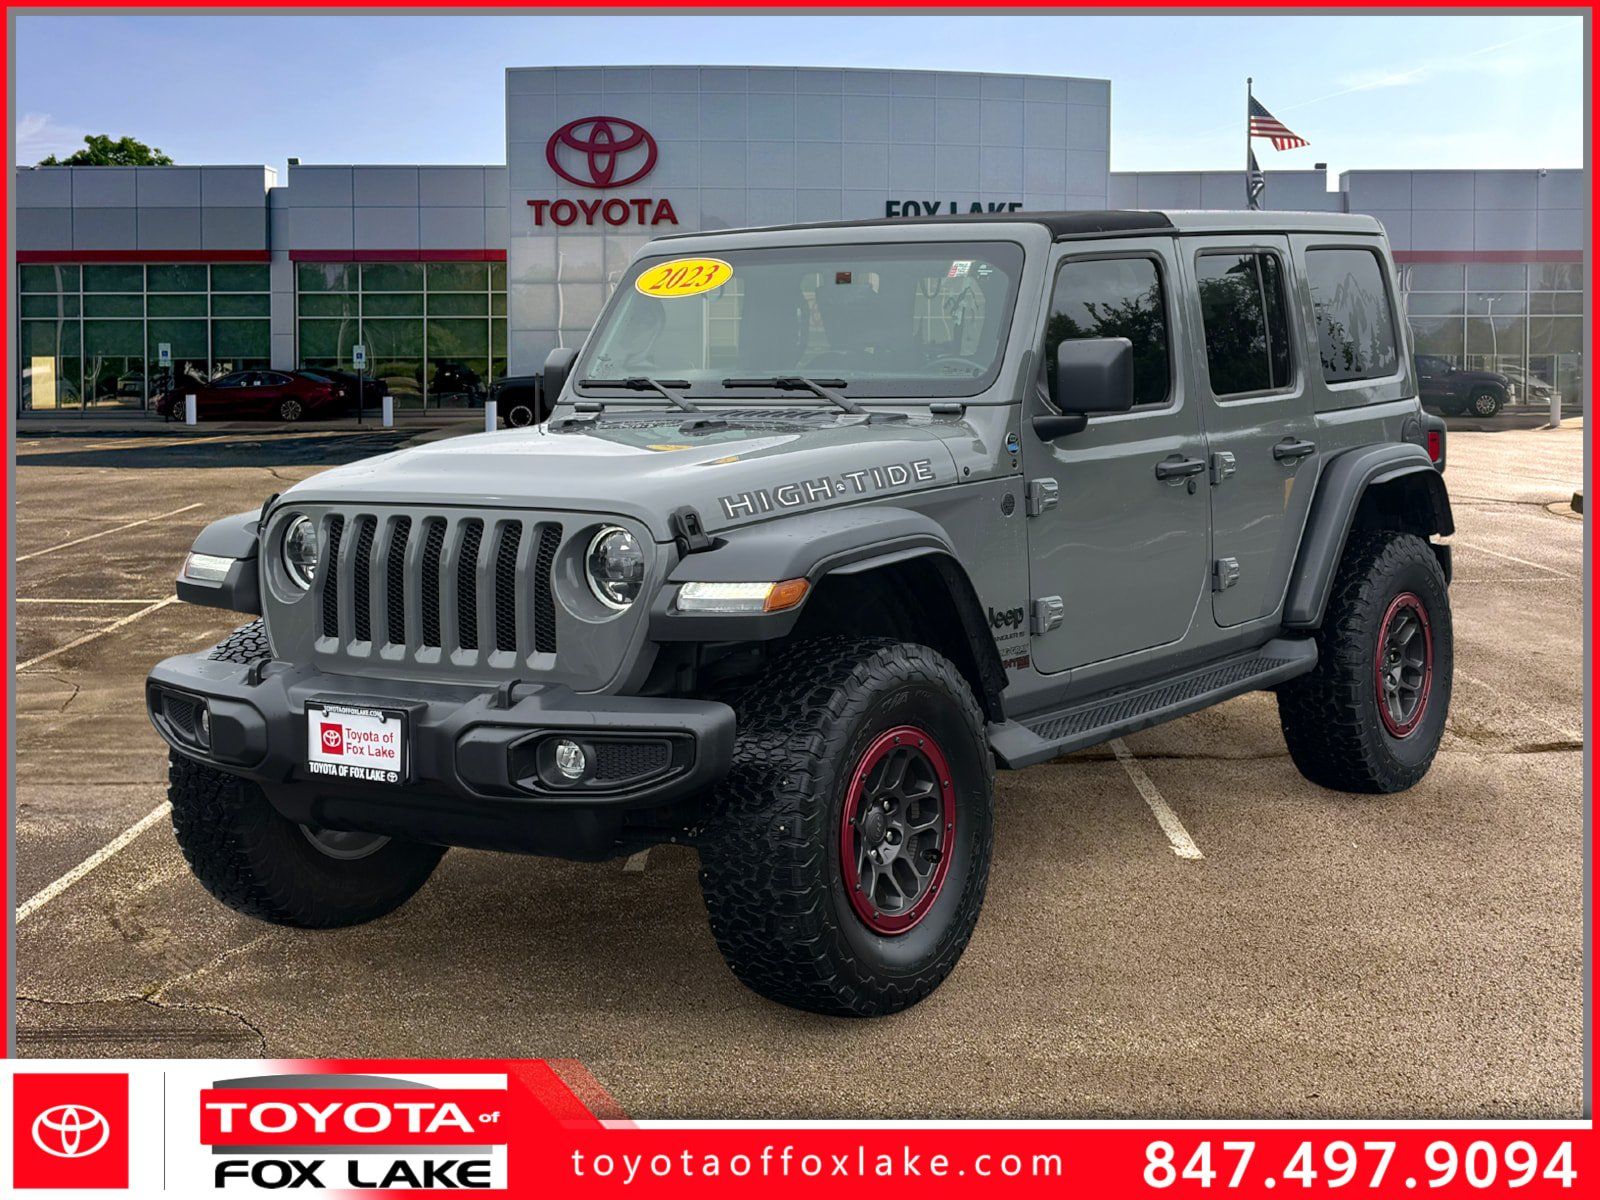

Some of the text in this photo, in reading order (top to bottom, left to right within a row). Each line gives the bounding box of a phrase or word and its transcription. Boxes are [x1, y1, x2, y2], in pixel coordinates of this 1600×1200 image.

[527, 198, 679, 226] TOYOTA
[650, 265, 720, 290] 2023
[719, 459, 935, 519] HIGH TIDE
[989, 607, 1023, 629] Jeep
[345, 727, 394, 743] Toyota of
[346, 743, 395, 758] Fox Lake
[309, 761, 386, 781] TOYOTA OF FOX LAKE
